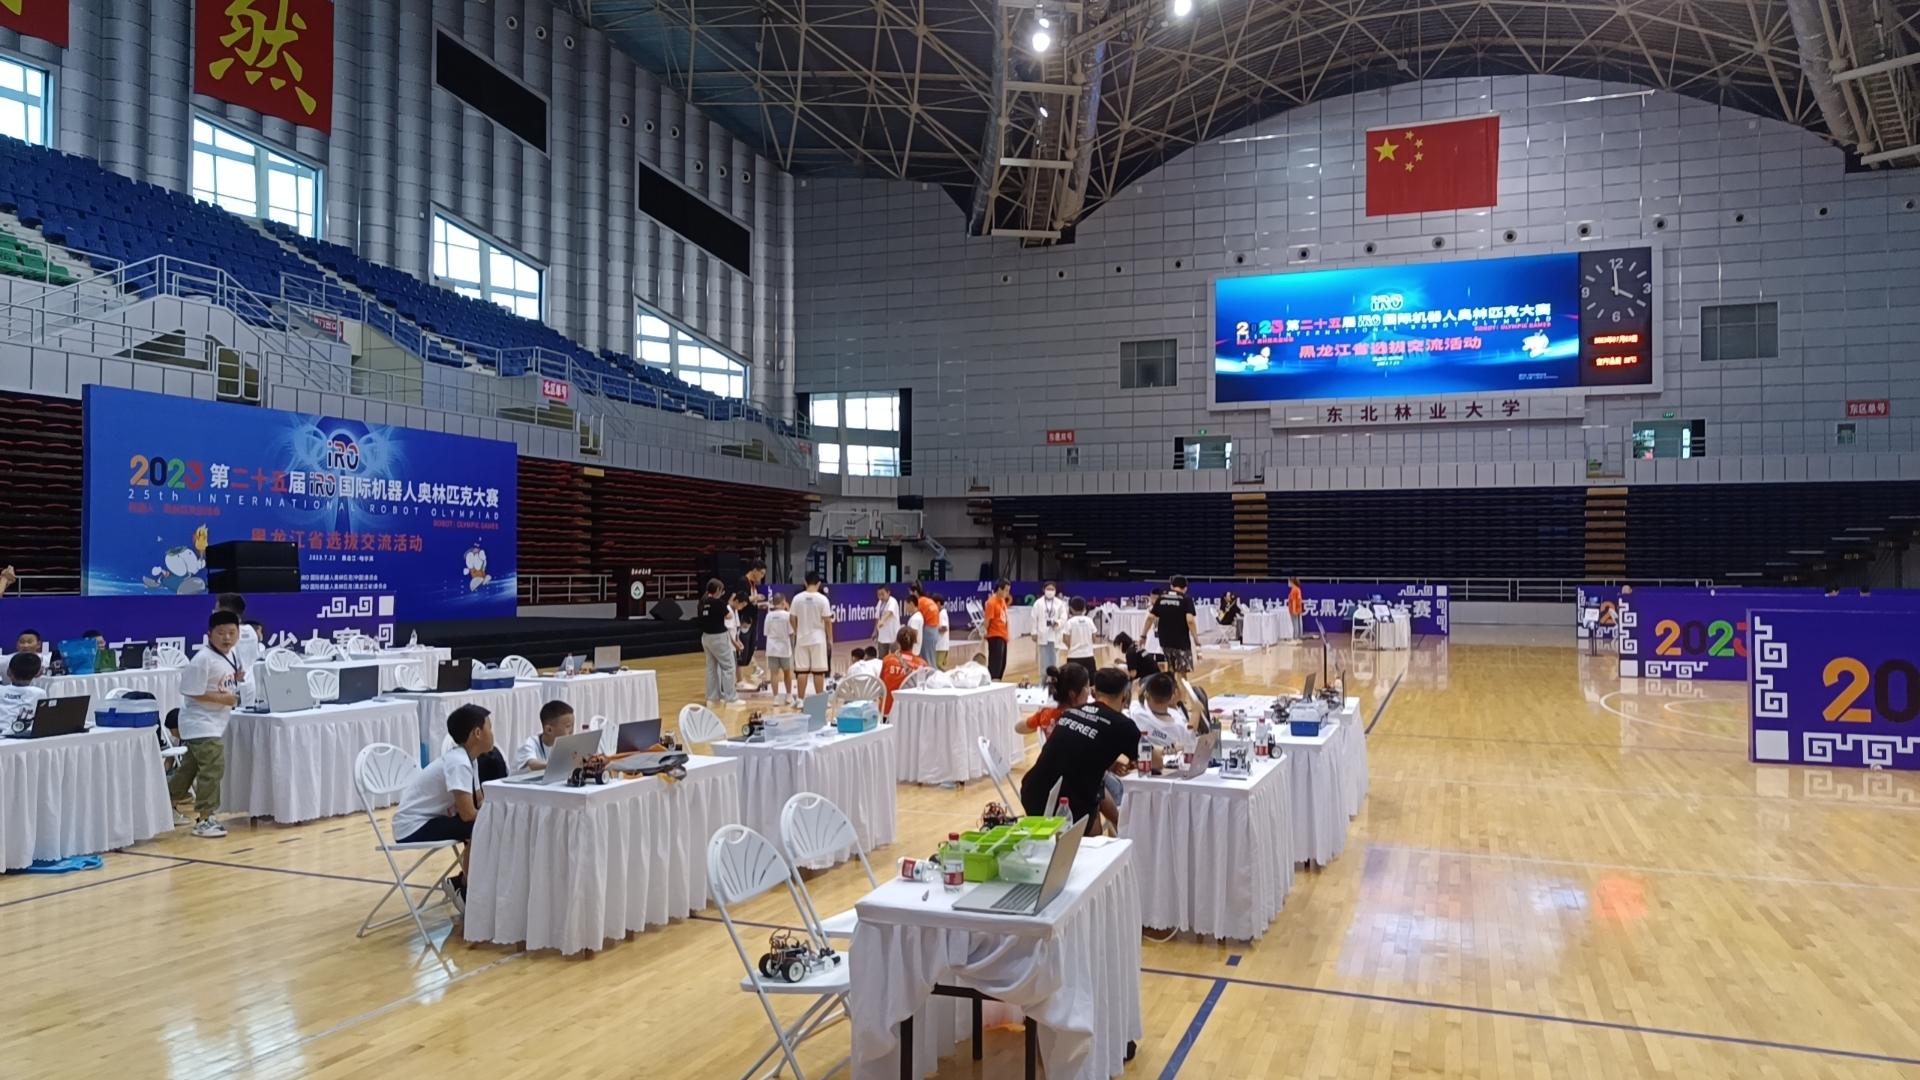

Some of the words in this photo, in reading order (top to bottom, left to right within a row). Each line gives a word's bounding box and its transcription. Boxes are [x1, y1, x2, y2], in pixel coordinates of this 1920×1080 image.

[1609, 258, 1623, 269] 12
[1581, 287, 1590, 298] 9
[1643, 283, 1652, 294] 3
[1411, 321, 1459, 330] ROBOT
[1472, 316, 1552, 327] OLYMPIAD
[1612, 311, 1621, 322] 6
[1299, 336, 1482, 359] 黑龙江省选拔交流活动
[1326, 399, 1520, 423] 东北林业大学
[129, 454, 205, 490] 2023
[128, 488, 179, 502] 25th
[198, 492, 355, 512] INTERNATIONAL
[370, 504, 419, 515] ROBOT
[431, 507, 499, 521] OLYMPIAD
